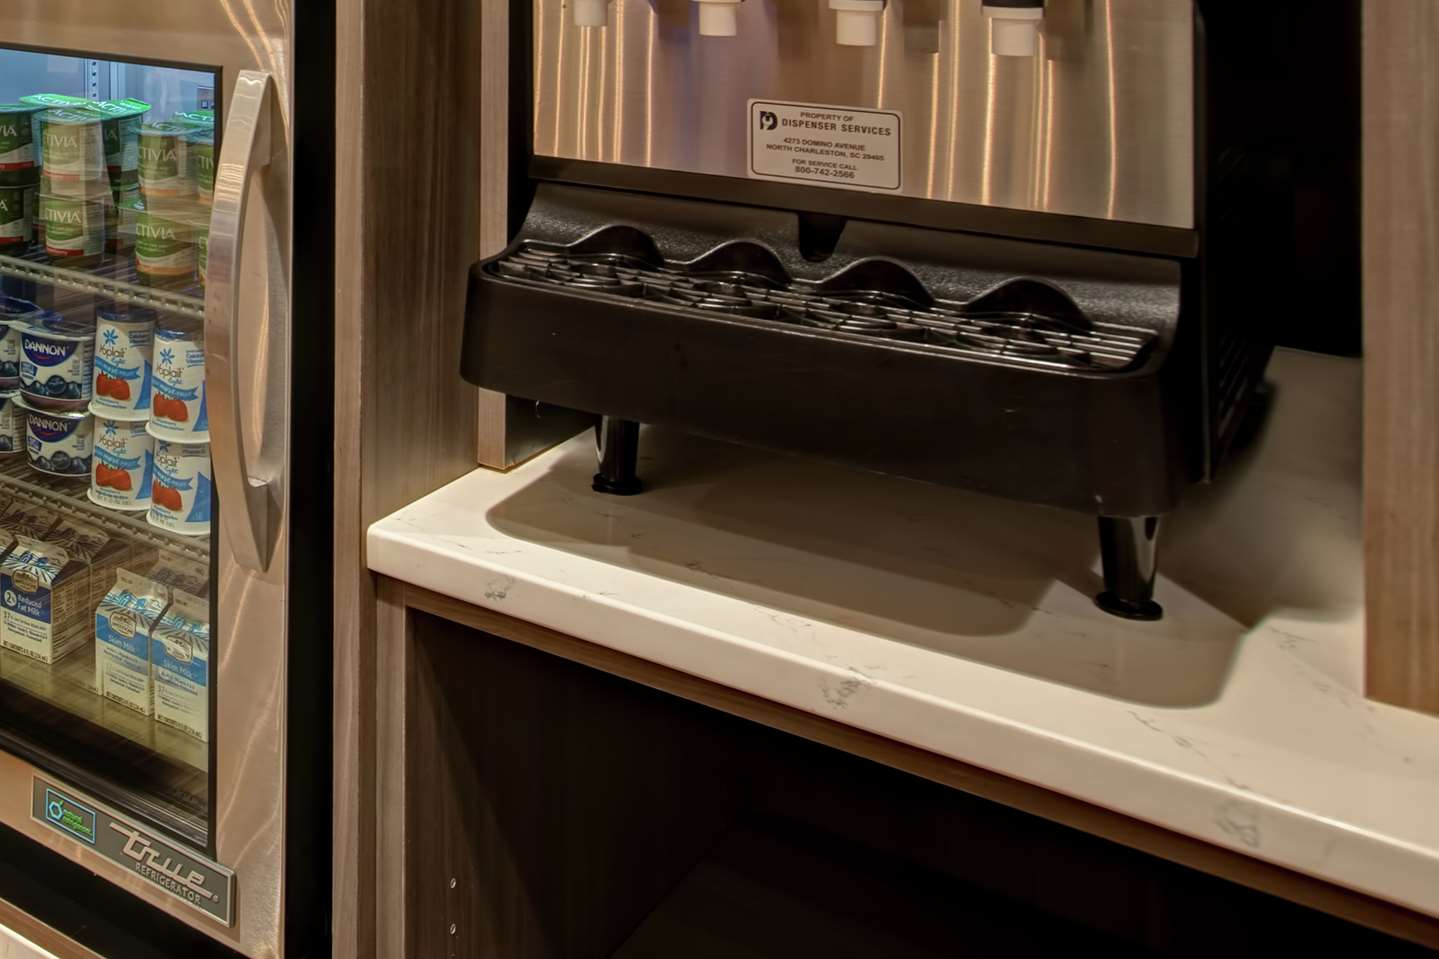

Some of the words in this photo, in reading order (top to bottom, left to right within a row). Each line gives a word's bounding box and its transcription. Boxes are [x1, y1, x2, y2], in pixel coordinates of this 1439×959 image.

[800, 112, 842, 121] PROPERTY
[782, 118, 837, 131] DISPENSER
[841, 123, 892, 137] SERVICES
[47, 134, 78, 148] TIVIA
[766, 143, 793, 151] NORTH
[136, 223, 176, 240] CTIVIA
[25, 339, 66, 357] DANNON
[29, 415, 68, 432] DANNON
[17, 594, 42, 609] Reduced
[135, 862, 201, 905] REFRIGERATOR
